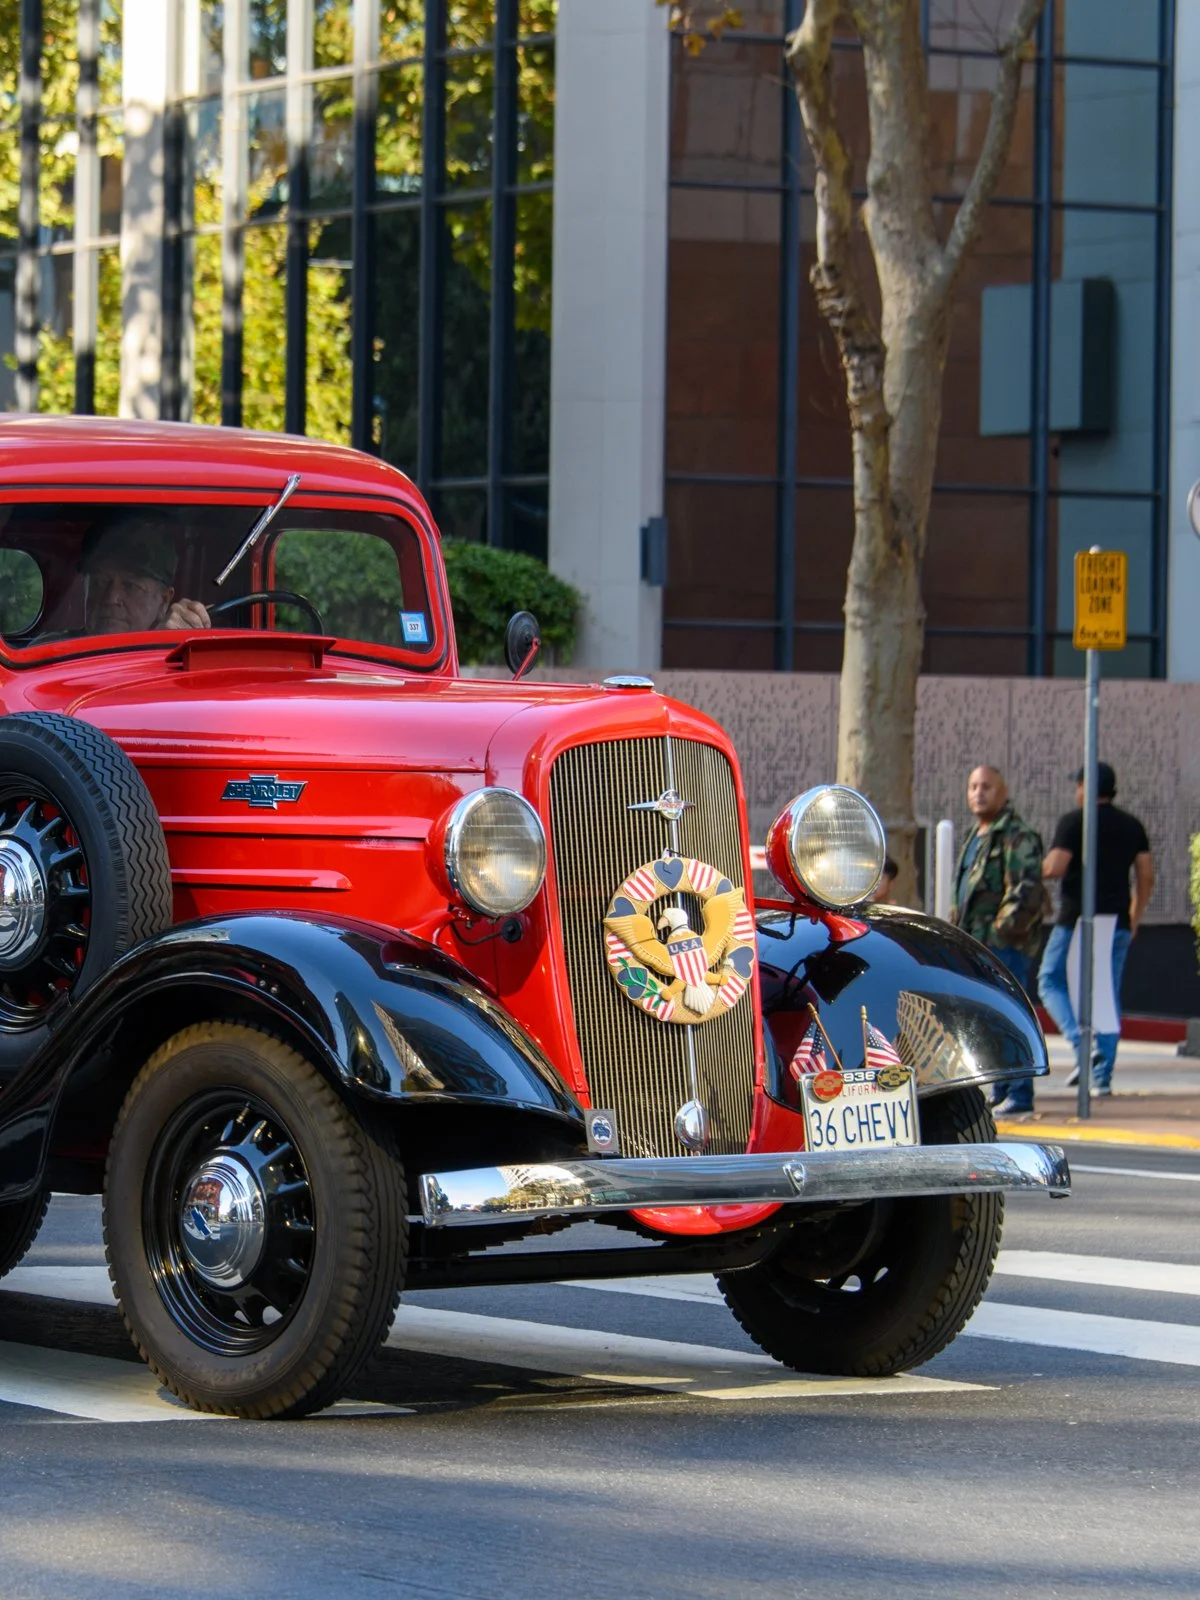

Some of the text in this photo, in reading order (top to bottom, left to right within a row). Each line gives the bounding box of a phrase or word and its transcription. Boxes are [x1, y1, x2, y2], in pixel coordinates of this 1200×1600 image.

[1080, 576, 1121, 594] LOADING
[1089, 595, 1112, 613] ZONE
[409, 623, 419, 631] 337
[229, 784, 298, 798] CHEVROLET
[842, 1070, 876, 1083] 936
[811, 1100, 910, 1147] 36 CHEVY
